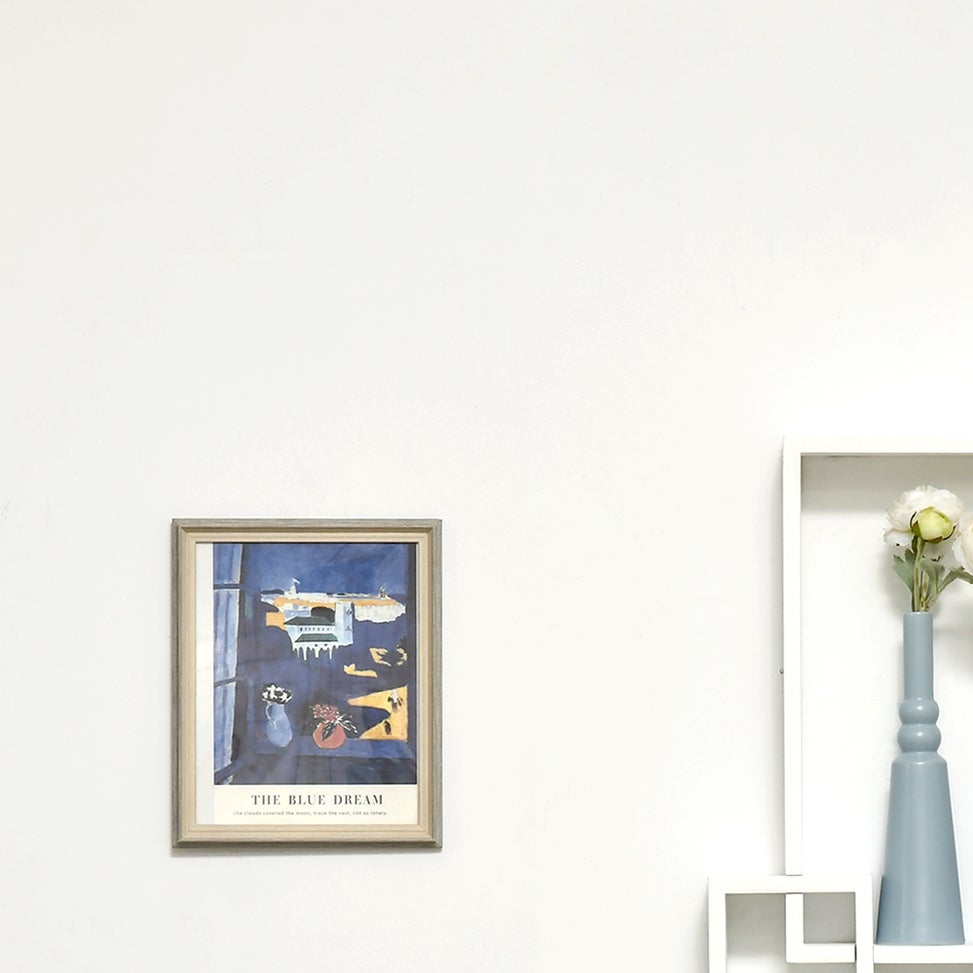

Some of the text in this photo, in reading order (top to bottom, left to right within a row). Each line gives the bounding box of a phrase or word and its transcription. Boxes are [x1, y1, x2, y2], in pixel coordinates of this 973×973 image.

[251, 794, 383, 806] THE BLUE DREAM
